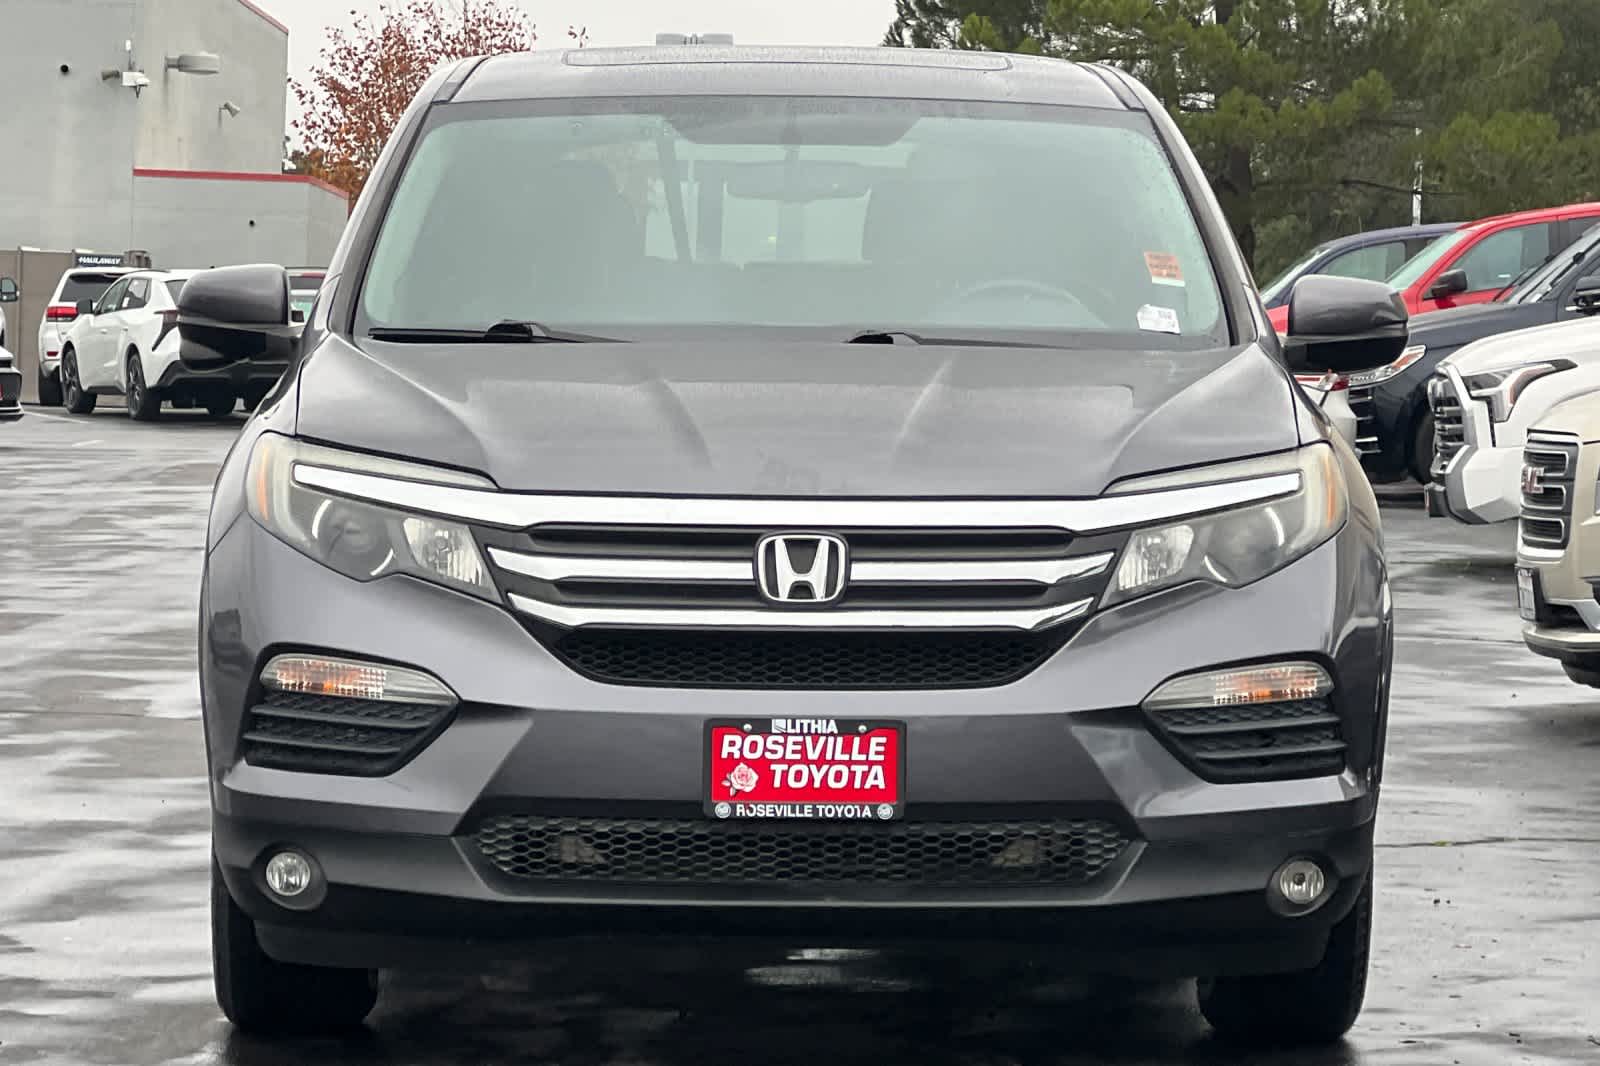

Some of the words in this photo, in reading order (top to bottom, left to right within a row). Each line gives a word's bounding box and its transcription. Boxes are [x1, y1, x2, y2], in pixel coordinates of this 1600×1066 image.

[787, 719, 838, 734] LITHIA
[720, 735, 887, 761] ROSEVILLE
[770, 764, 886, 789] TOYOTA
